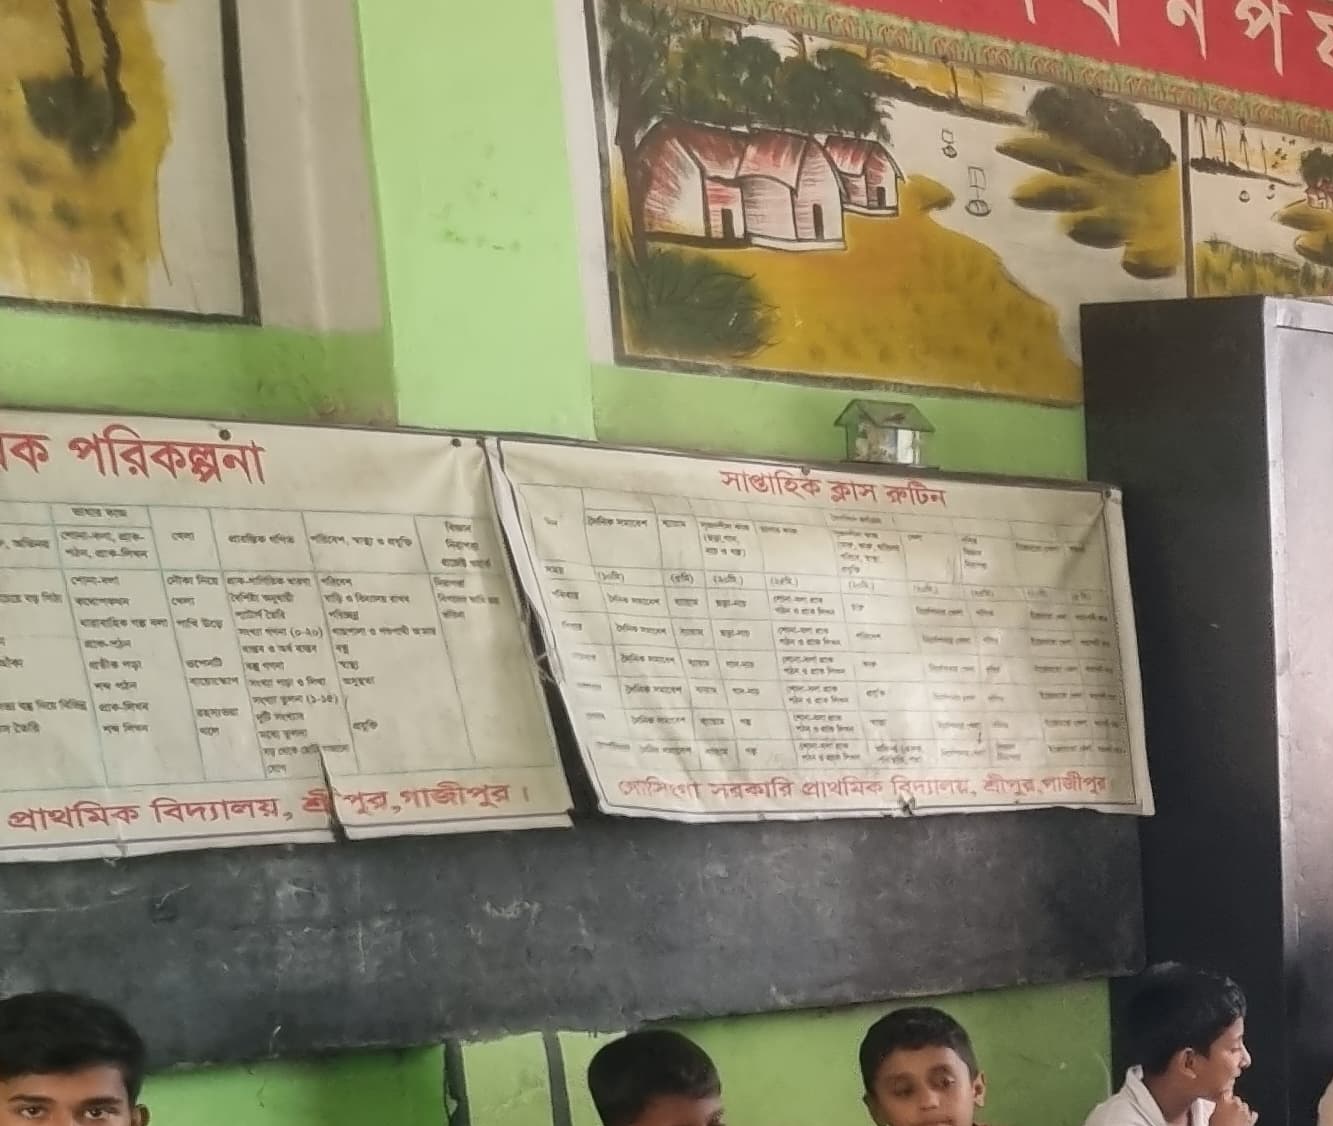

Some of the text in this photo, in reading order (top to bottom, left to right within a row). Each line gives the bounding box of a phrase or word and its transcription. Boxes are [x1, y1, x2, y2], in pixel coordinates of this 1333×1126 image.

[1234, 0, 1294, 77] প
[68, 424, 266, 485] পরিকল্পনা
[720, 469, 947, 507] সাপ্তাহিক ক্লাস রুটিন
[708, 775, 794, 800] সরকারি
[801, 775, 884, 799] প্রাথমিক
[8, 800, 140, 831] প্রাথমিক
